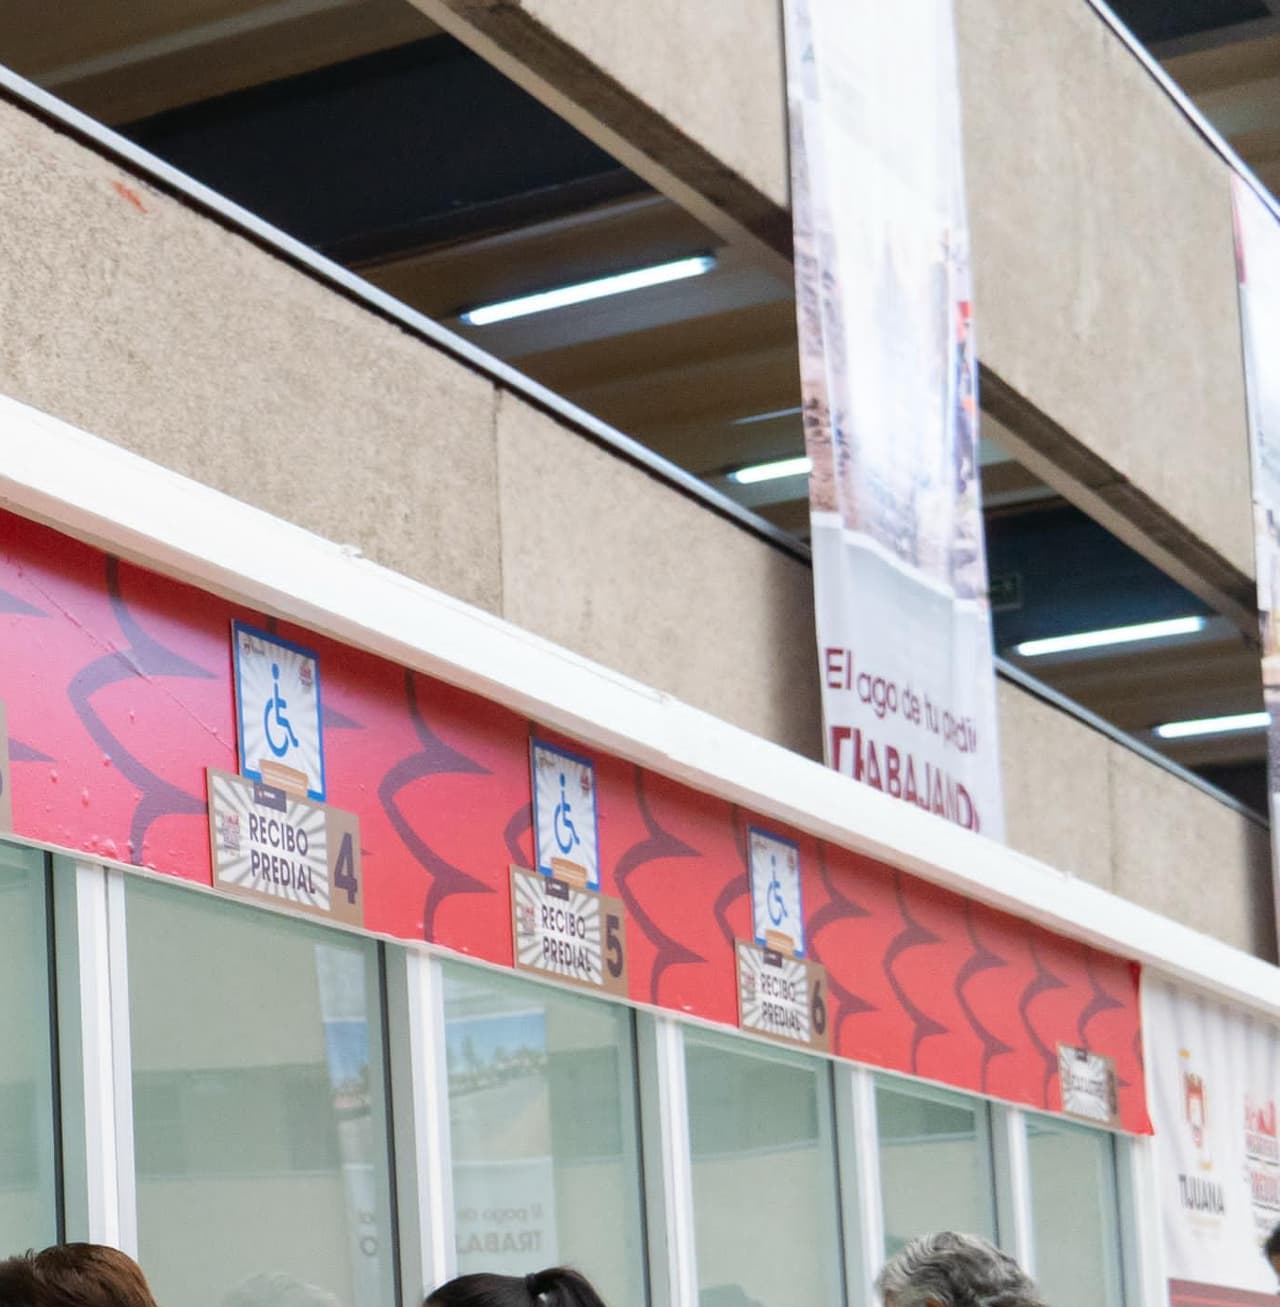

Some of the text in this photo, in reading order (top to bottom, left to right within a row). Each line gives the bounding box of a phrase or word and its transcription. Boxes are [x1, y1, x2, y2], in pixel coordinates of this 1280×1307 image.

[825, 648, 852, 691] El
[857, 671, 897, 719] ago
[830, 725, 980, 833] TRABAJAND
[249, 812, 308, 856] RECIBO
[251, 849, 316, 894] PREDIAL
[334, 832, 358, 904] 4
[542, 904, 586, 939] RECIBO
[543, 936, 592, 972] PREDIAL
[606, 914, 623, 978] 5
[761, 973, 796, 1002] RECIBO
[811, 979, 826, 1036] 6
[762, 1001, 801, 1031] PREDIAL
[1178, 1174, 1225, 1215] TIJUANA
